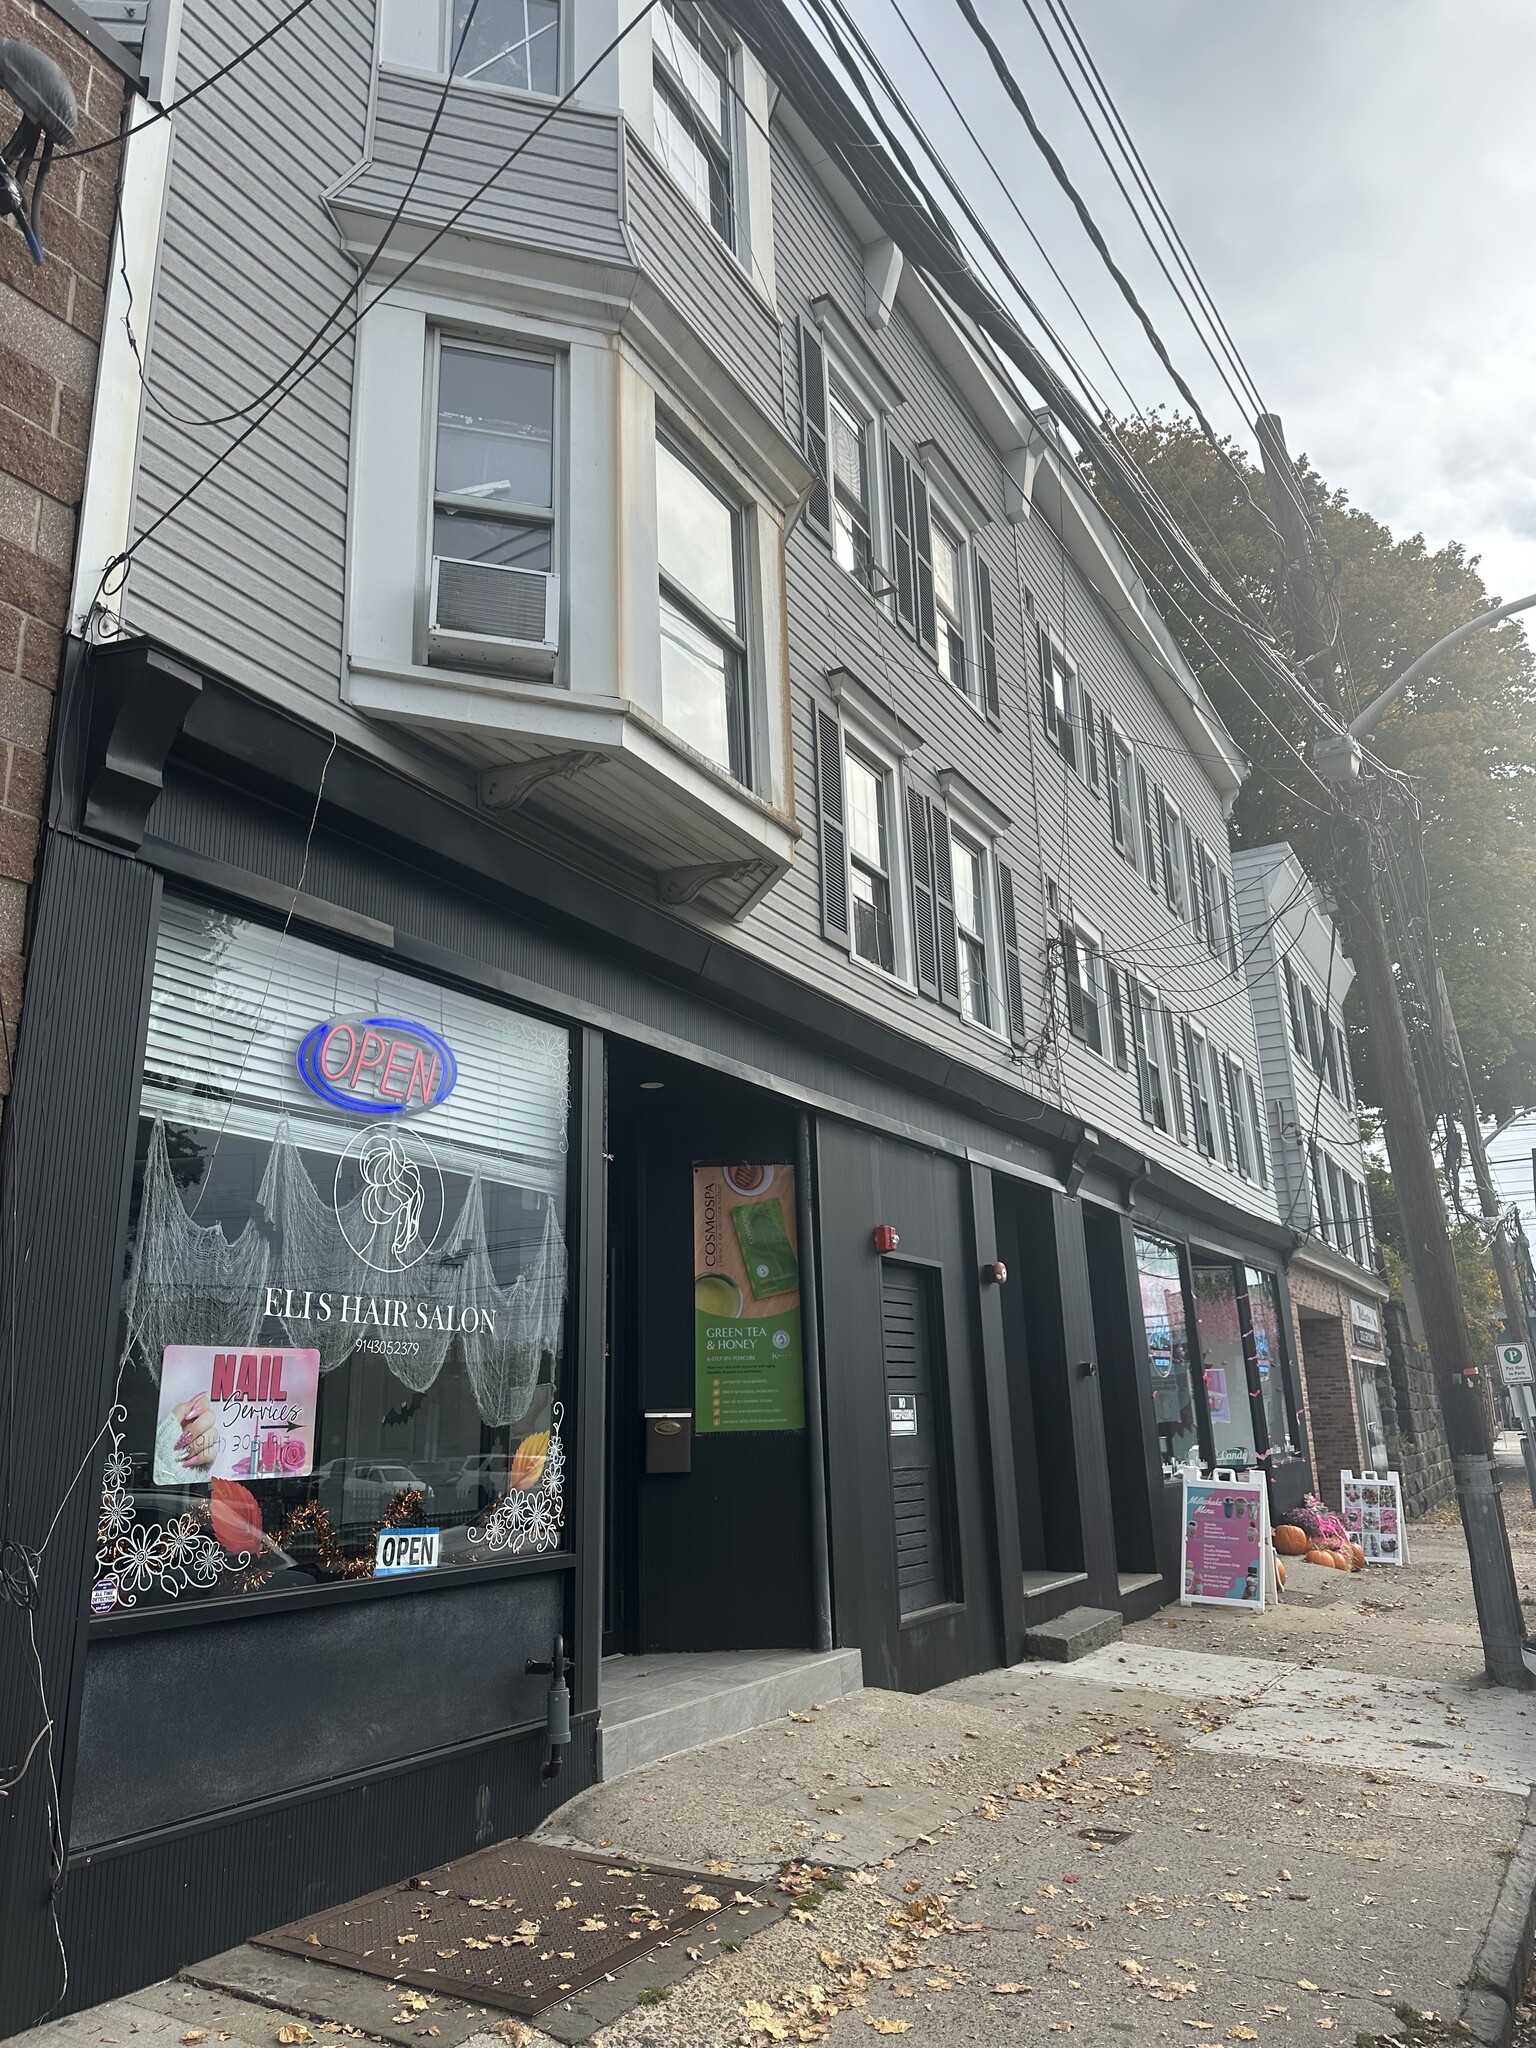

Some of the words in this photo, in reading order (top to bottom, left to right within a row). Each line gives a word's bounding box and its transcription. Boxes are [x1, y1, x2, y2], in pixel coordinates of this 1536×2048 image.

[322, 1024, 438, 1104] OPEN
[705, 1182, 716, 1267] COSMOSPA
[262, 1286, 332, 1322] ELIS
[339, 1294, 409, 1328] HAIR
[415, 1302, 497, 1334] SALON
[706, 1327, 743, 1338] GREEN
[746, 1327, 767, 1337] TEA
[706, 1340, 715, 1350] &
[717, 1339, 757, 1350] HONEY
[355, 1338, 420, 1355] 9143052379
[210, 1354, 287, 1402] NAIL
[222, 1390, 302, 1428] Services
[1216, 1448, 1248, 1463] Candy
[1187, 1496, 1223, 1507] Milkshake
[1194, 1505, 1215, 1515] Menu
[382, 1536, 434, 1567] OPEN
